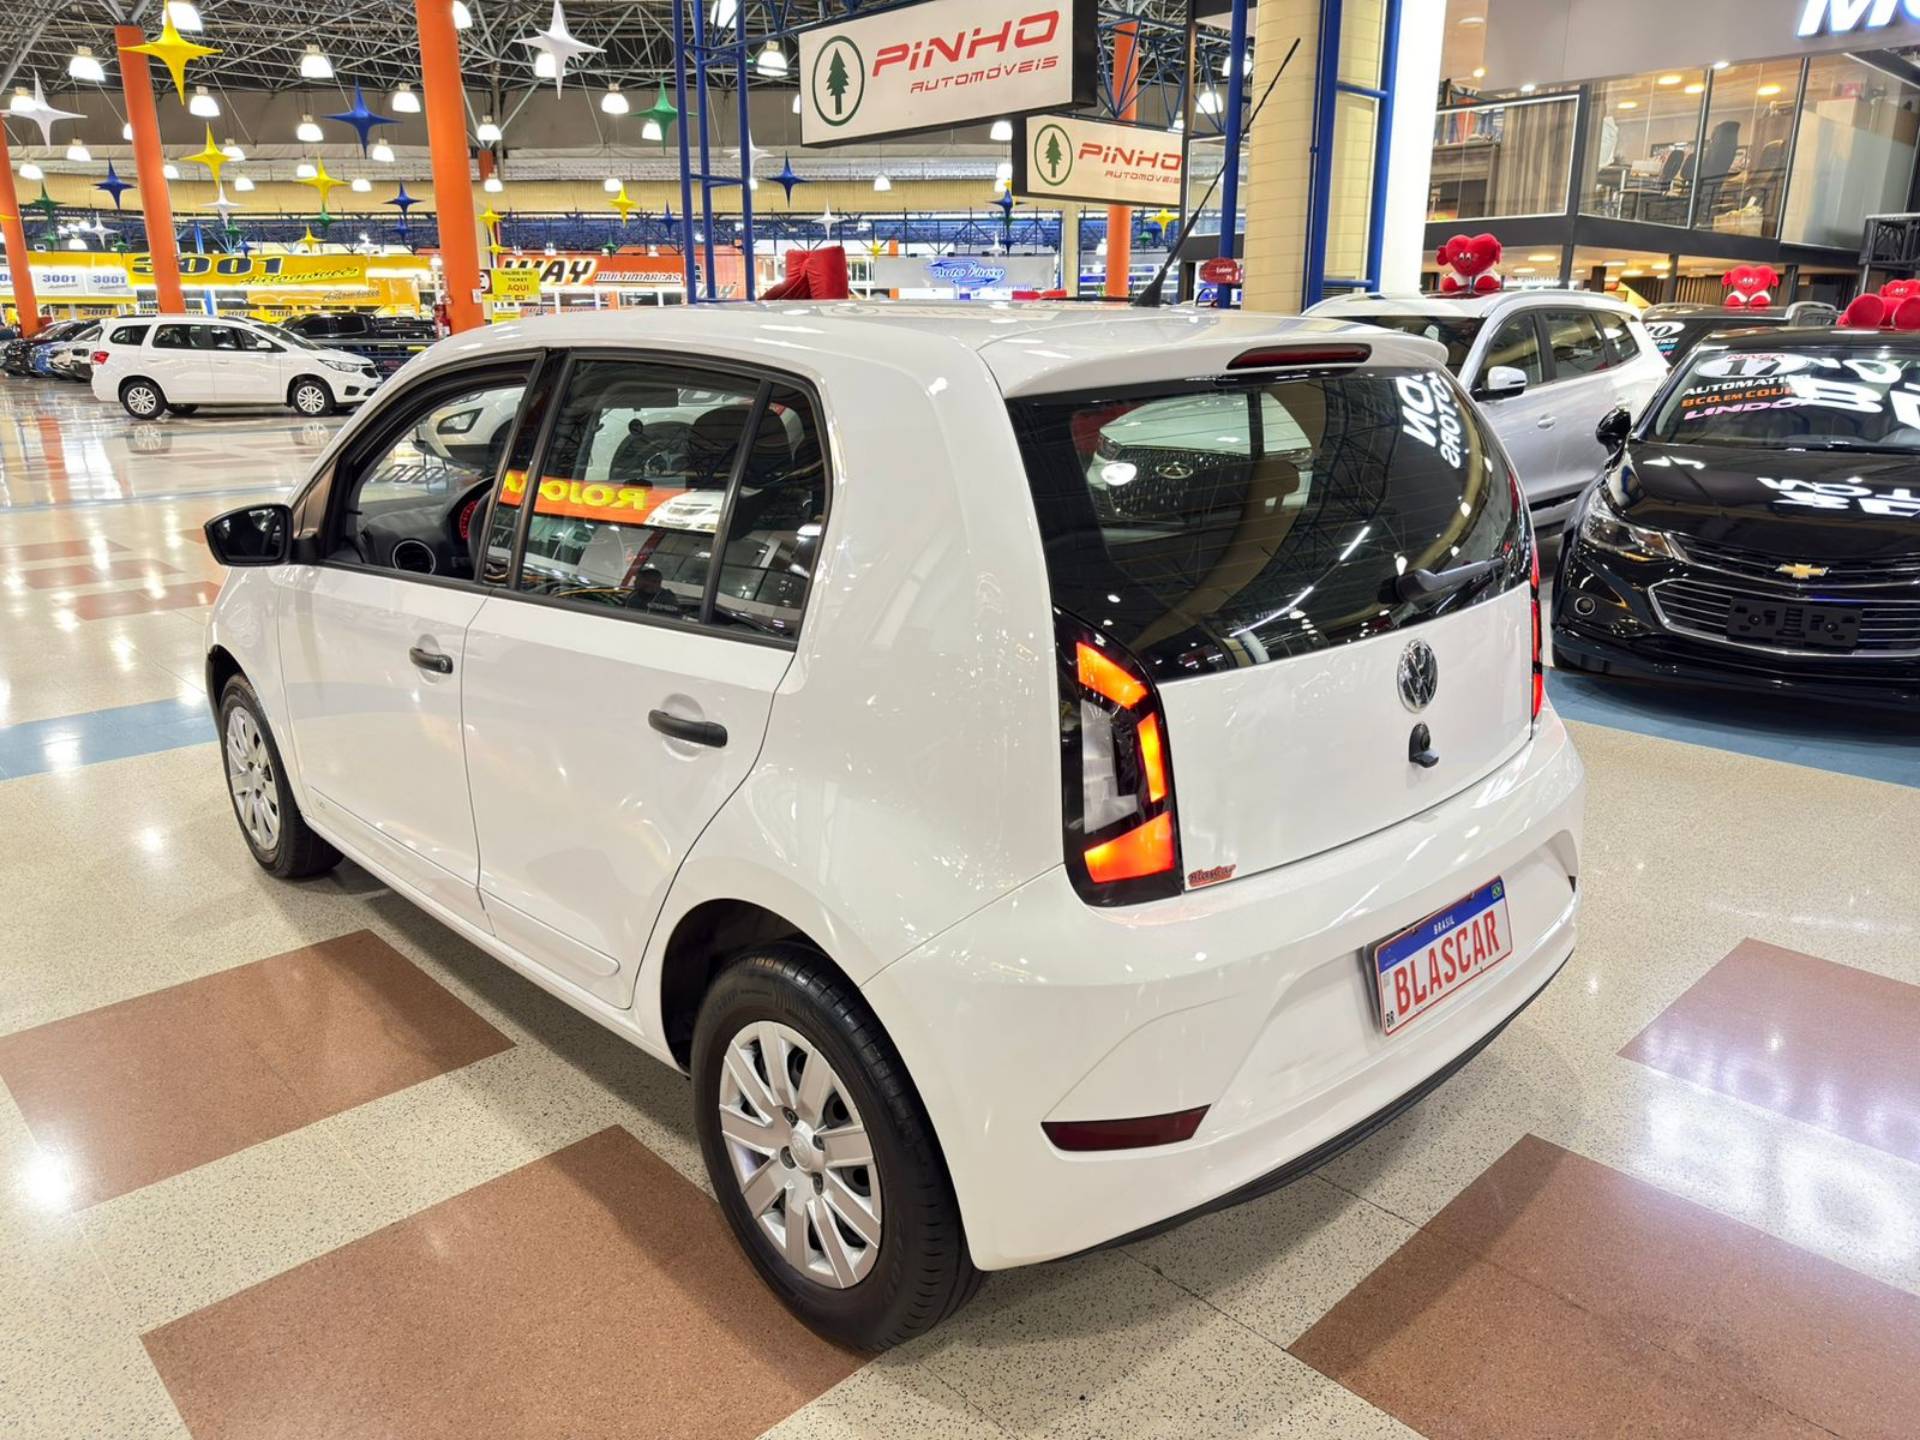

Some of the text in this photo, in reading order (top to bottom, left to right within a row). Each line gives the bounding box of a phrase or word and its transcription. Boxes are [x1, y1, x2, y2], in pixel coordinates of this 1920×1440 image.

[42, 274, 77, 283] 3001
[93, 275, 126, 284] 3001
[507, 284, 529, 292] AQUI
[1433, 915, 1455, 935] BRASIL
[1394, 910, 1500, 1016] BLASCAR
